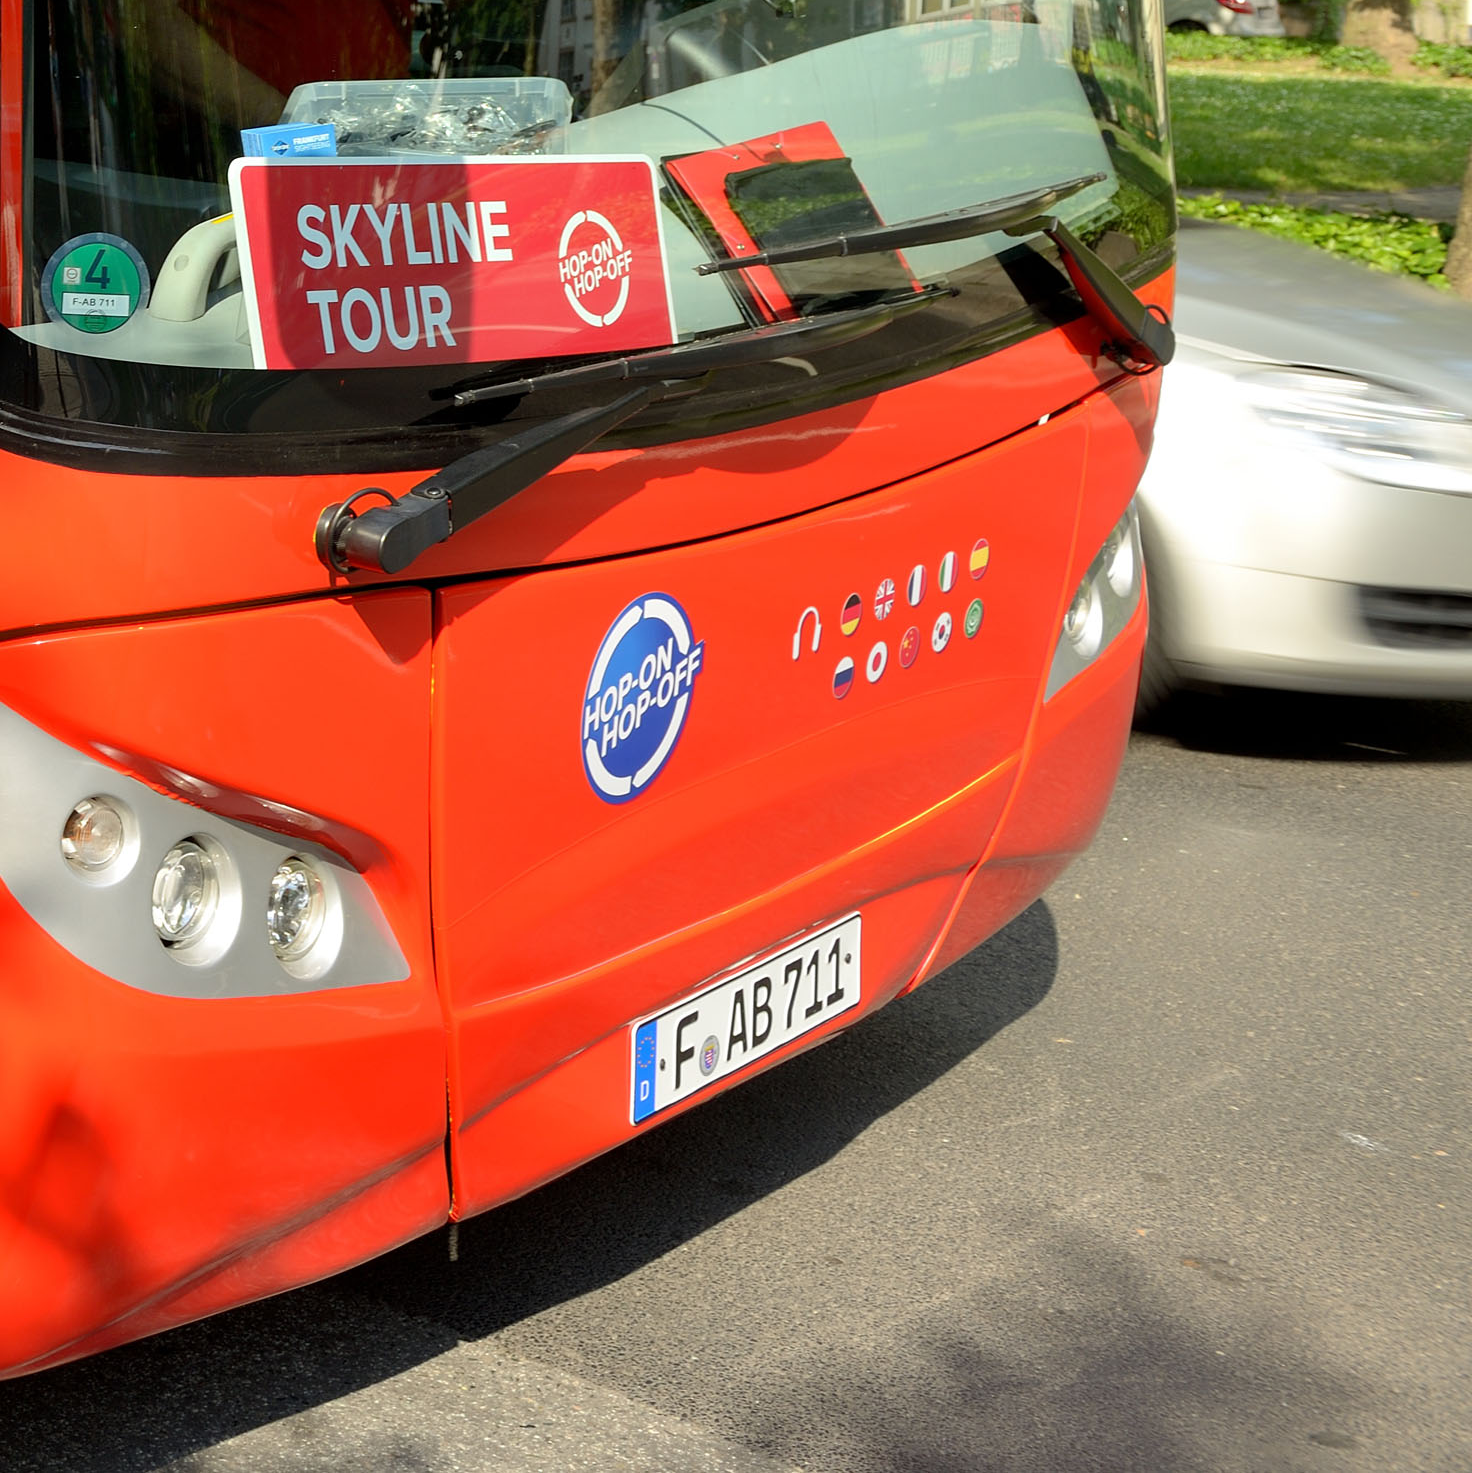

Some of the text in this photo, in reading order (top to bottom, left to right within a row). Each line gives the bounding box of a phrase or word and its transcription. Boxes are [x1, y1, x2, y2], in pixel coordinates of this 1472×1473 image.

[296, 201, 514, 269] SKYLINE
[558, 237, 613, 283] HOP-ON
[85, 249, 111, 289] 4
[573, 249, 633, 298] HOP-OFF
[72, 298, 115, 307] F-AB 711
[306, 285, 457, 355] TOUR
[584, 637, 674, 740] HOP-ON
[601, 647, 701, 758] HOP-OFF
[673, 937, 845, 1091] F AB 711
[640, 1079, 649, 1101] D
